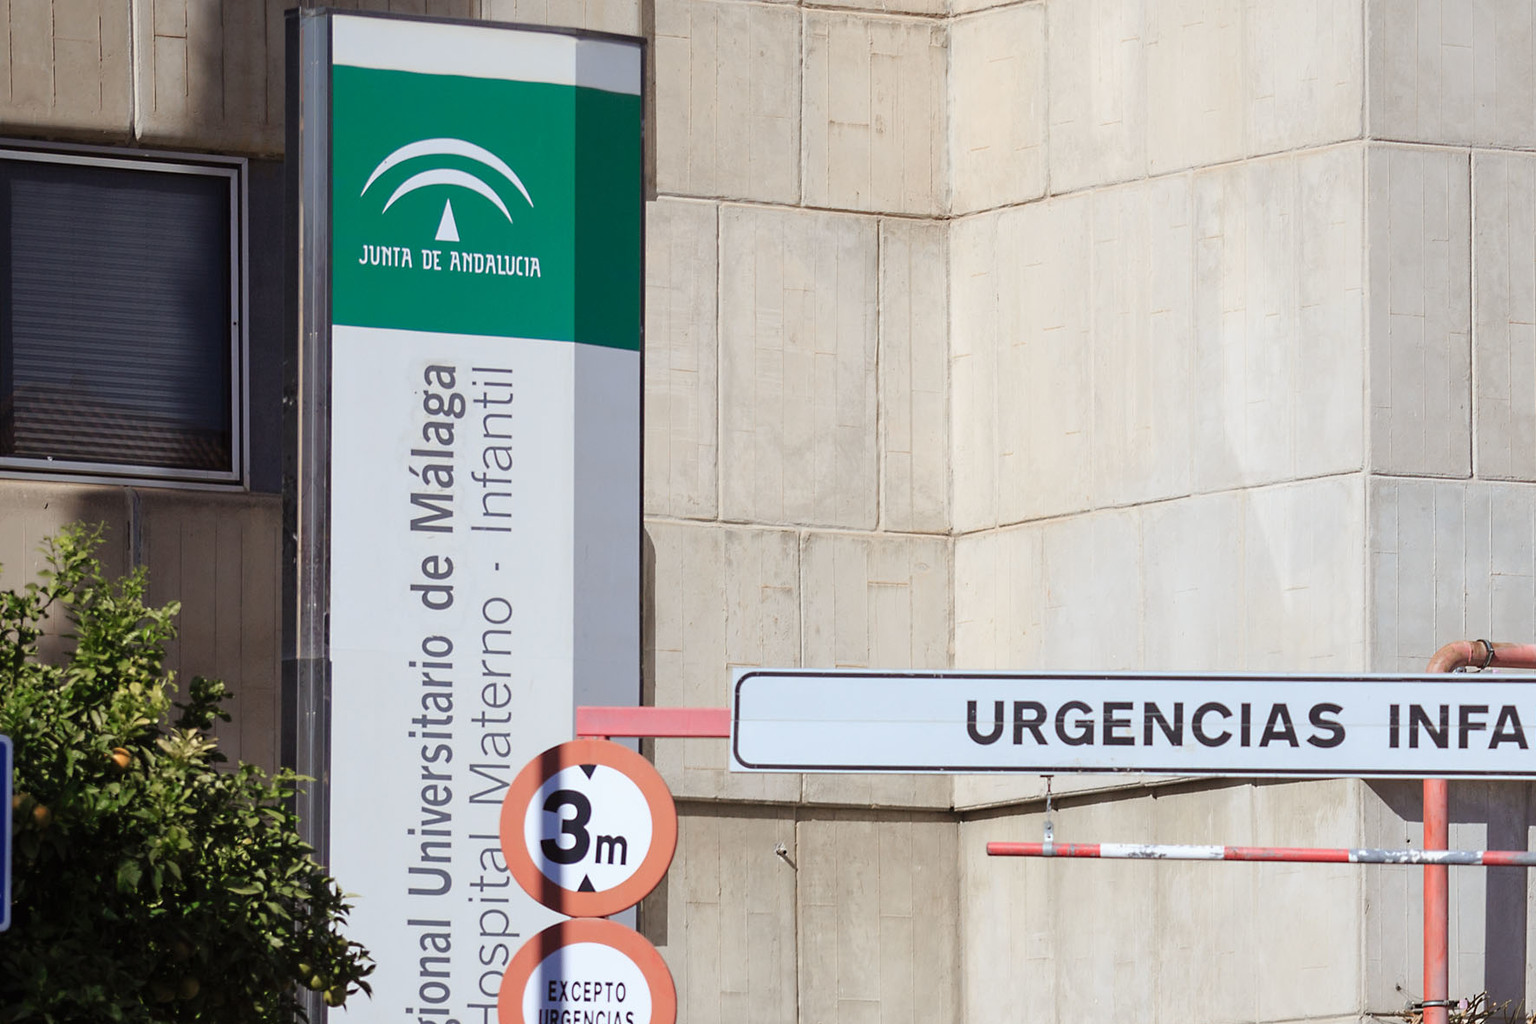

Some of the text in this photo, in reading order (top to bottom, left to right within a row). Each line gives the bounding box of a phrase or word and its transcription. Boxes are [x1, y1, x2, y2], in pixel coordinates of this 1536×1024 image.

[358, 244, 541, 278] JUNTA DE ANDALUCIA
[408, 364, 466, 533] Málaga
[471, 367, 514, 532] Infantil
[410, 555, 454, 611] de
[469, 597, 513, 804] Materno
[965, 698, 1347, 749] URGENCIAS
[407, 635, 454, 897] Universitario
[547, 979, 627, 1004] EXCEPTO
